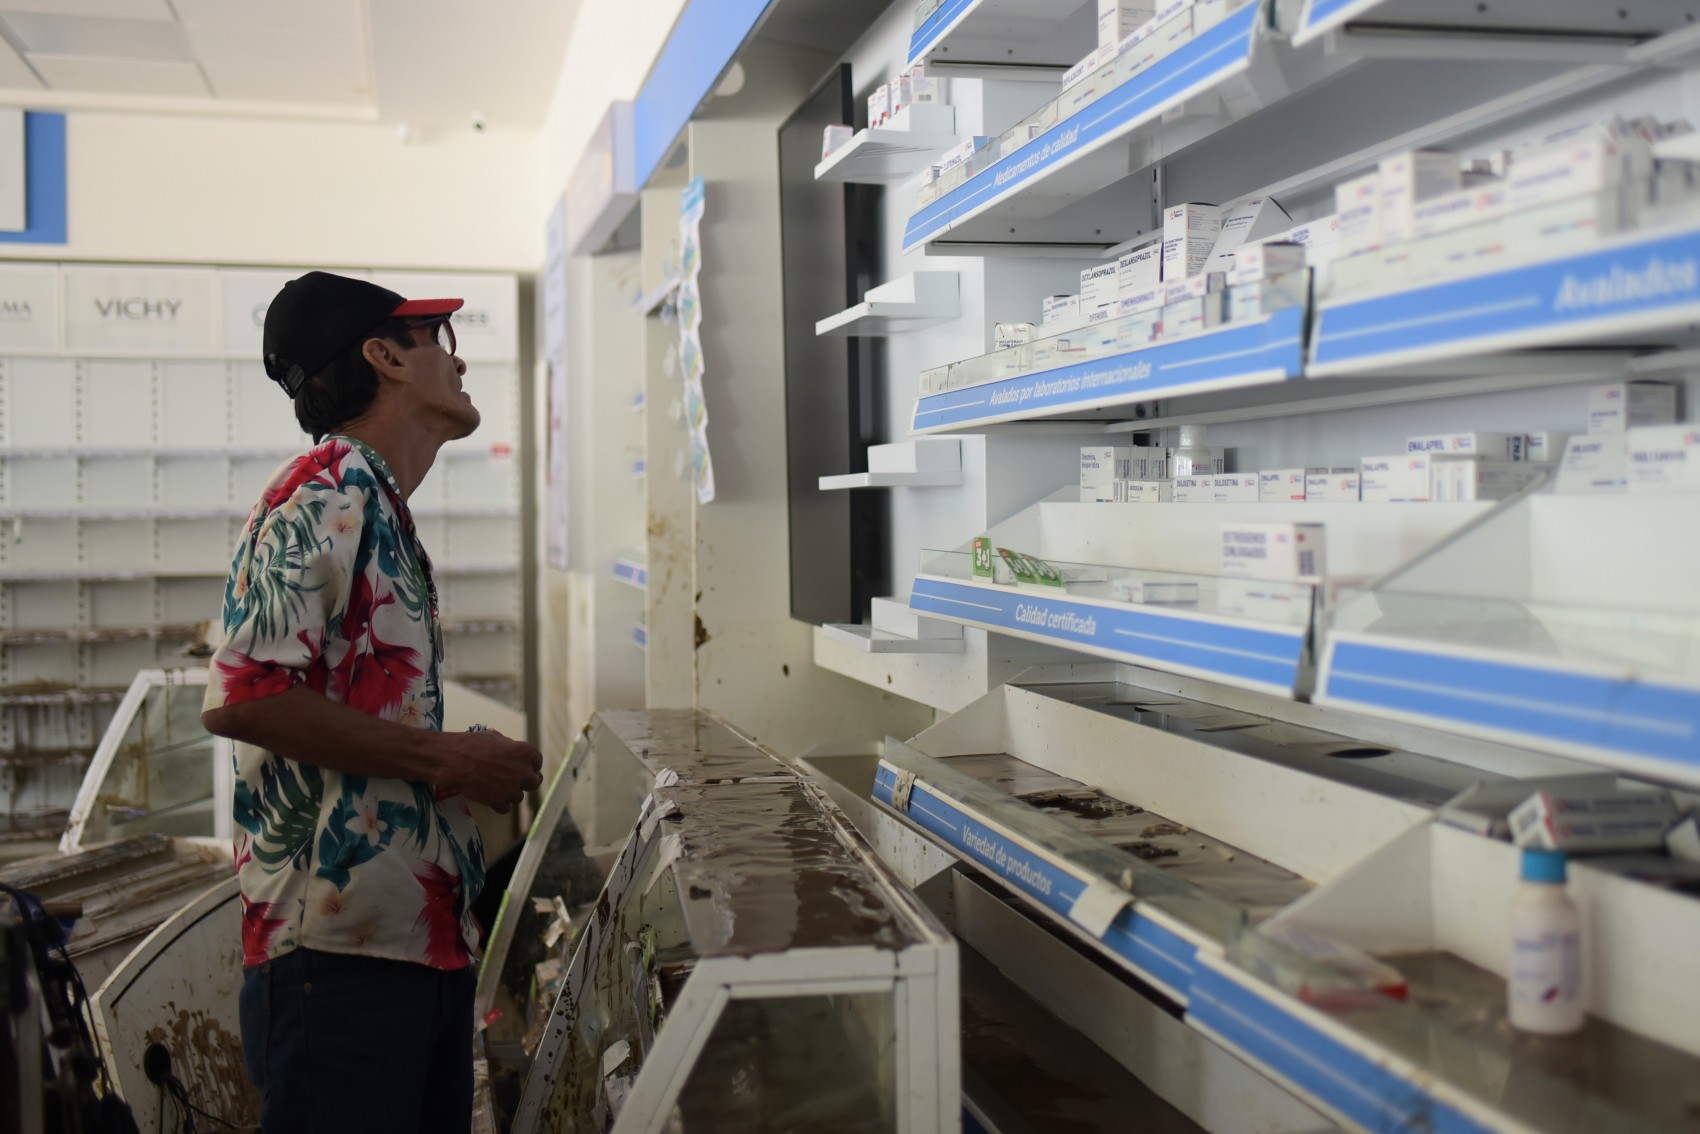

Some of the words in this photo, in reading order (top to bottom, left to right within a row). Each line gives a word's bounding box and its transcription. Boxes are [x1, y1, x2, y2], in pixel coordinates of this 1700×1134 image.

[993, 153, 1040, 189] Medicamentos
[1040, 143, 1050, 160] de
[1050, 124, 1079, 155] calidad
[1119, 251, 1152, 268] DEXLANSOPRAZOL
[1081, 266, 1116, 282] DEXLANSOPRAZOL
[94, 297, 182, 319] VICHY
[990, 387, 1019, 405] Avalados
[1019, 387, 1034, 404] por
[1034, 375, 1080, 398] laboratorios
[1081, 360, 1152, 390] internacionales
[1408, 440, 1445, 451] ENALAPRIL
[1214, 479, 1239, 487] DULOXETINA
[1015, 604, 1046, 626] Calidad
[1047, 610, 1096, 636] certificada
[963, 825, 996, 860] Variedad
[996, 846, 1007, 868] de
[1006, 856, 1052, 896] productos
